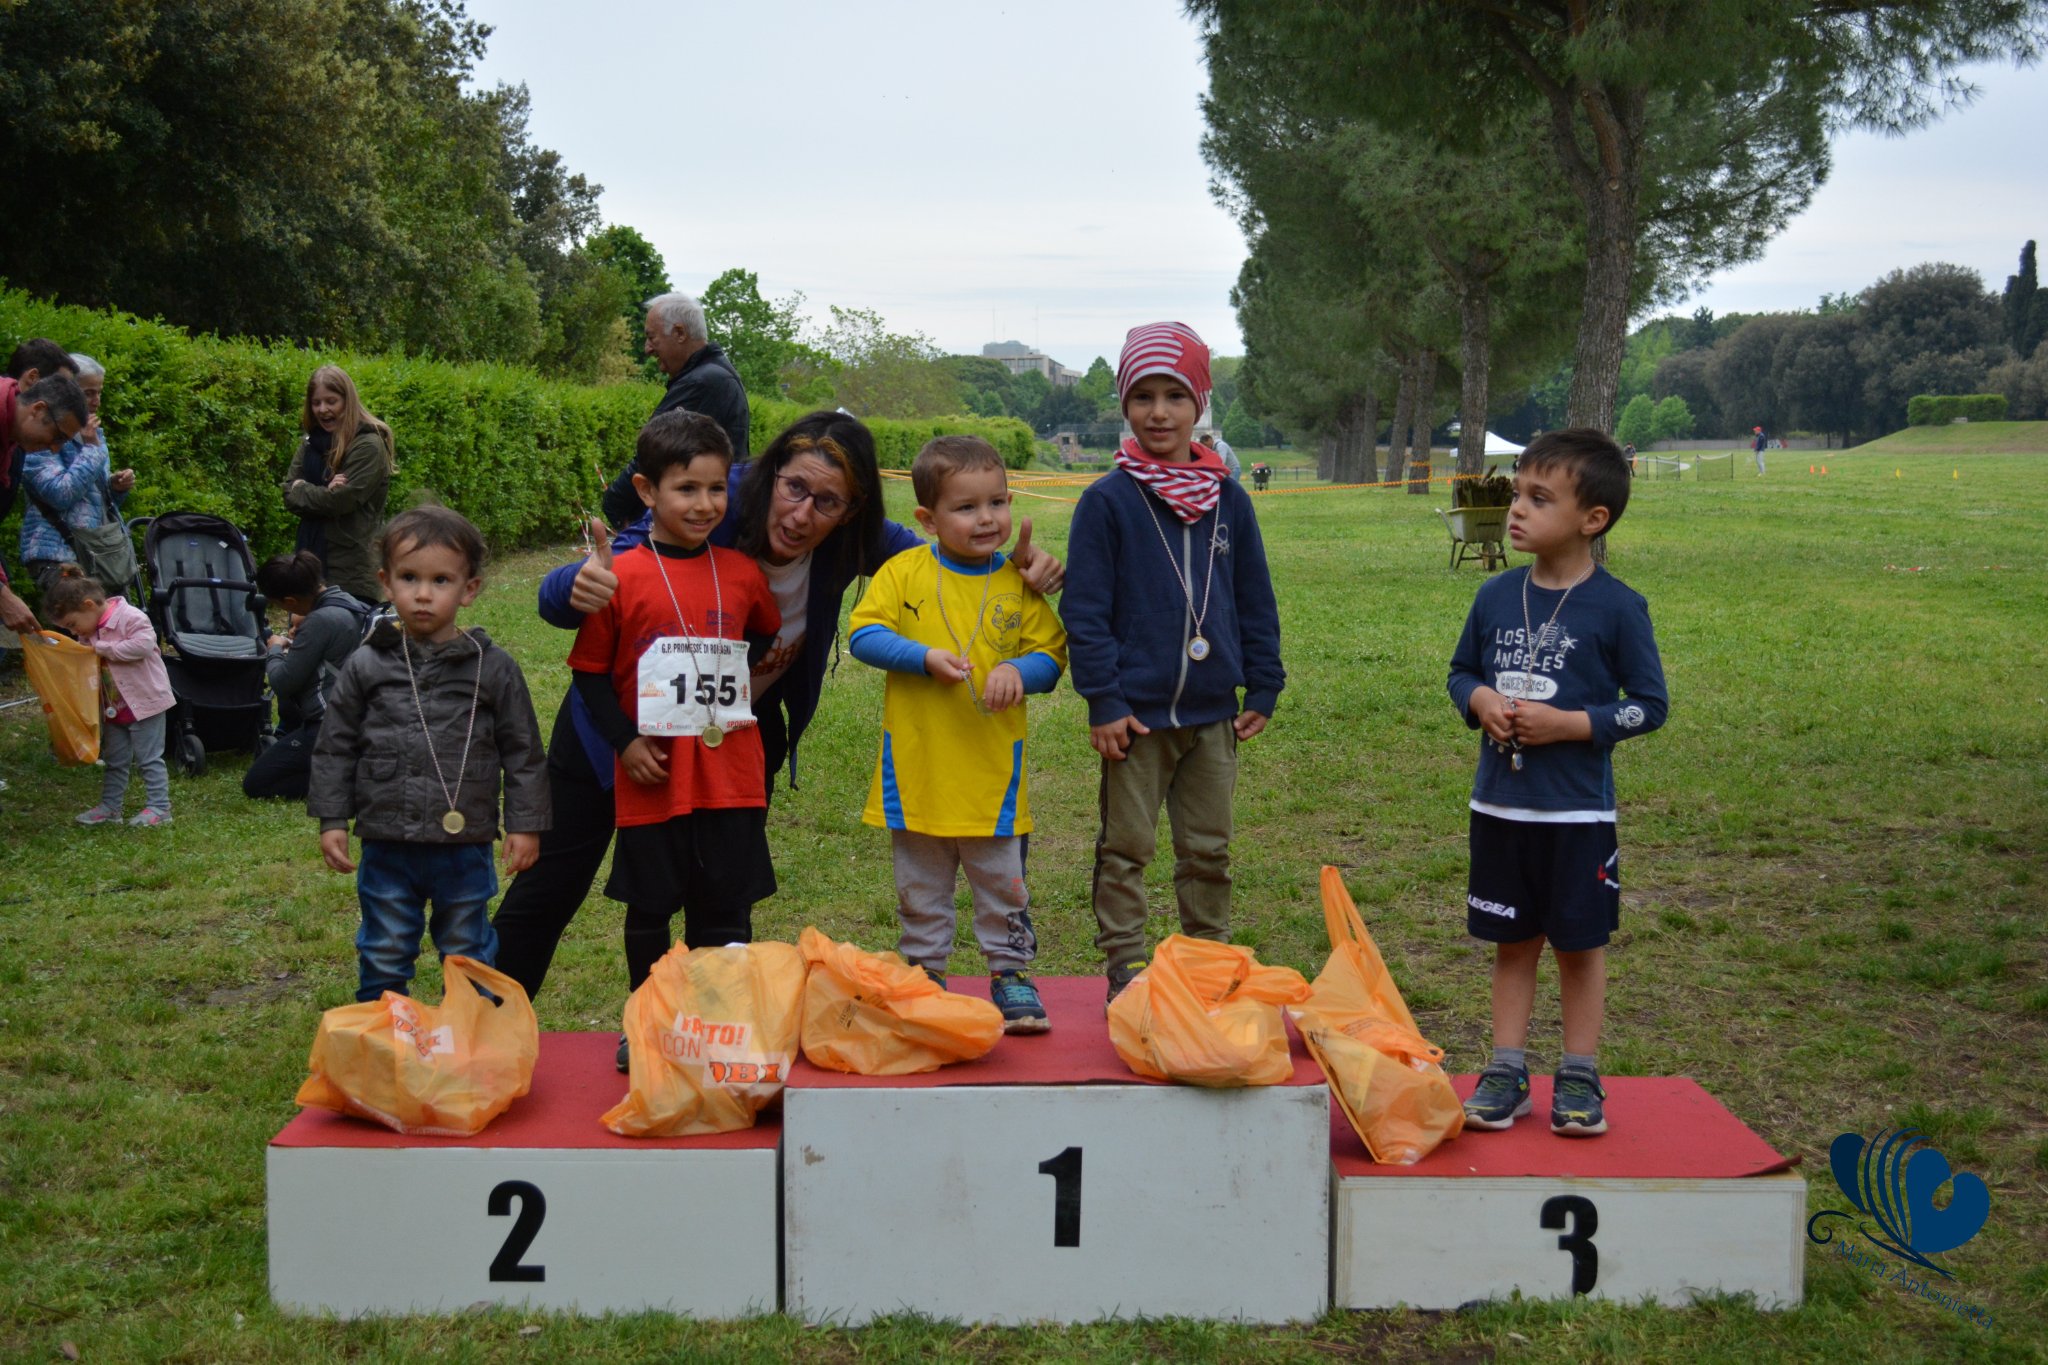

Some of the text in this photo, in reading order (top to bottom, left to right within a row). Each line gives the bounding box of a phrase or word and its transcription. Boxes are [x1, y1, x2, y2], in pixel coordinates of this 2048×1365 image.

[661, 643, 672, 654] G.P.
[673, 643, 702, 654] PROMESSE
[1496, 628, 1526, 646] LOS
[1493, 648, 1565, 672] ANGELES
[669, 673, 737, 707] 155
[1467, 893, 1516, 919] LEGEA
[663, 1033, 701, 1058] CON
[681, 1016, 746, 1047] FATO!
[1038, 1146, 1083, 1248] 1
[487, 1180, 547, 1283] 2
[1540, 1194, 1599, 1298] 3
